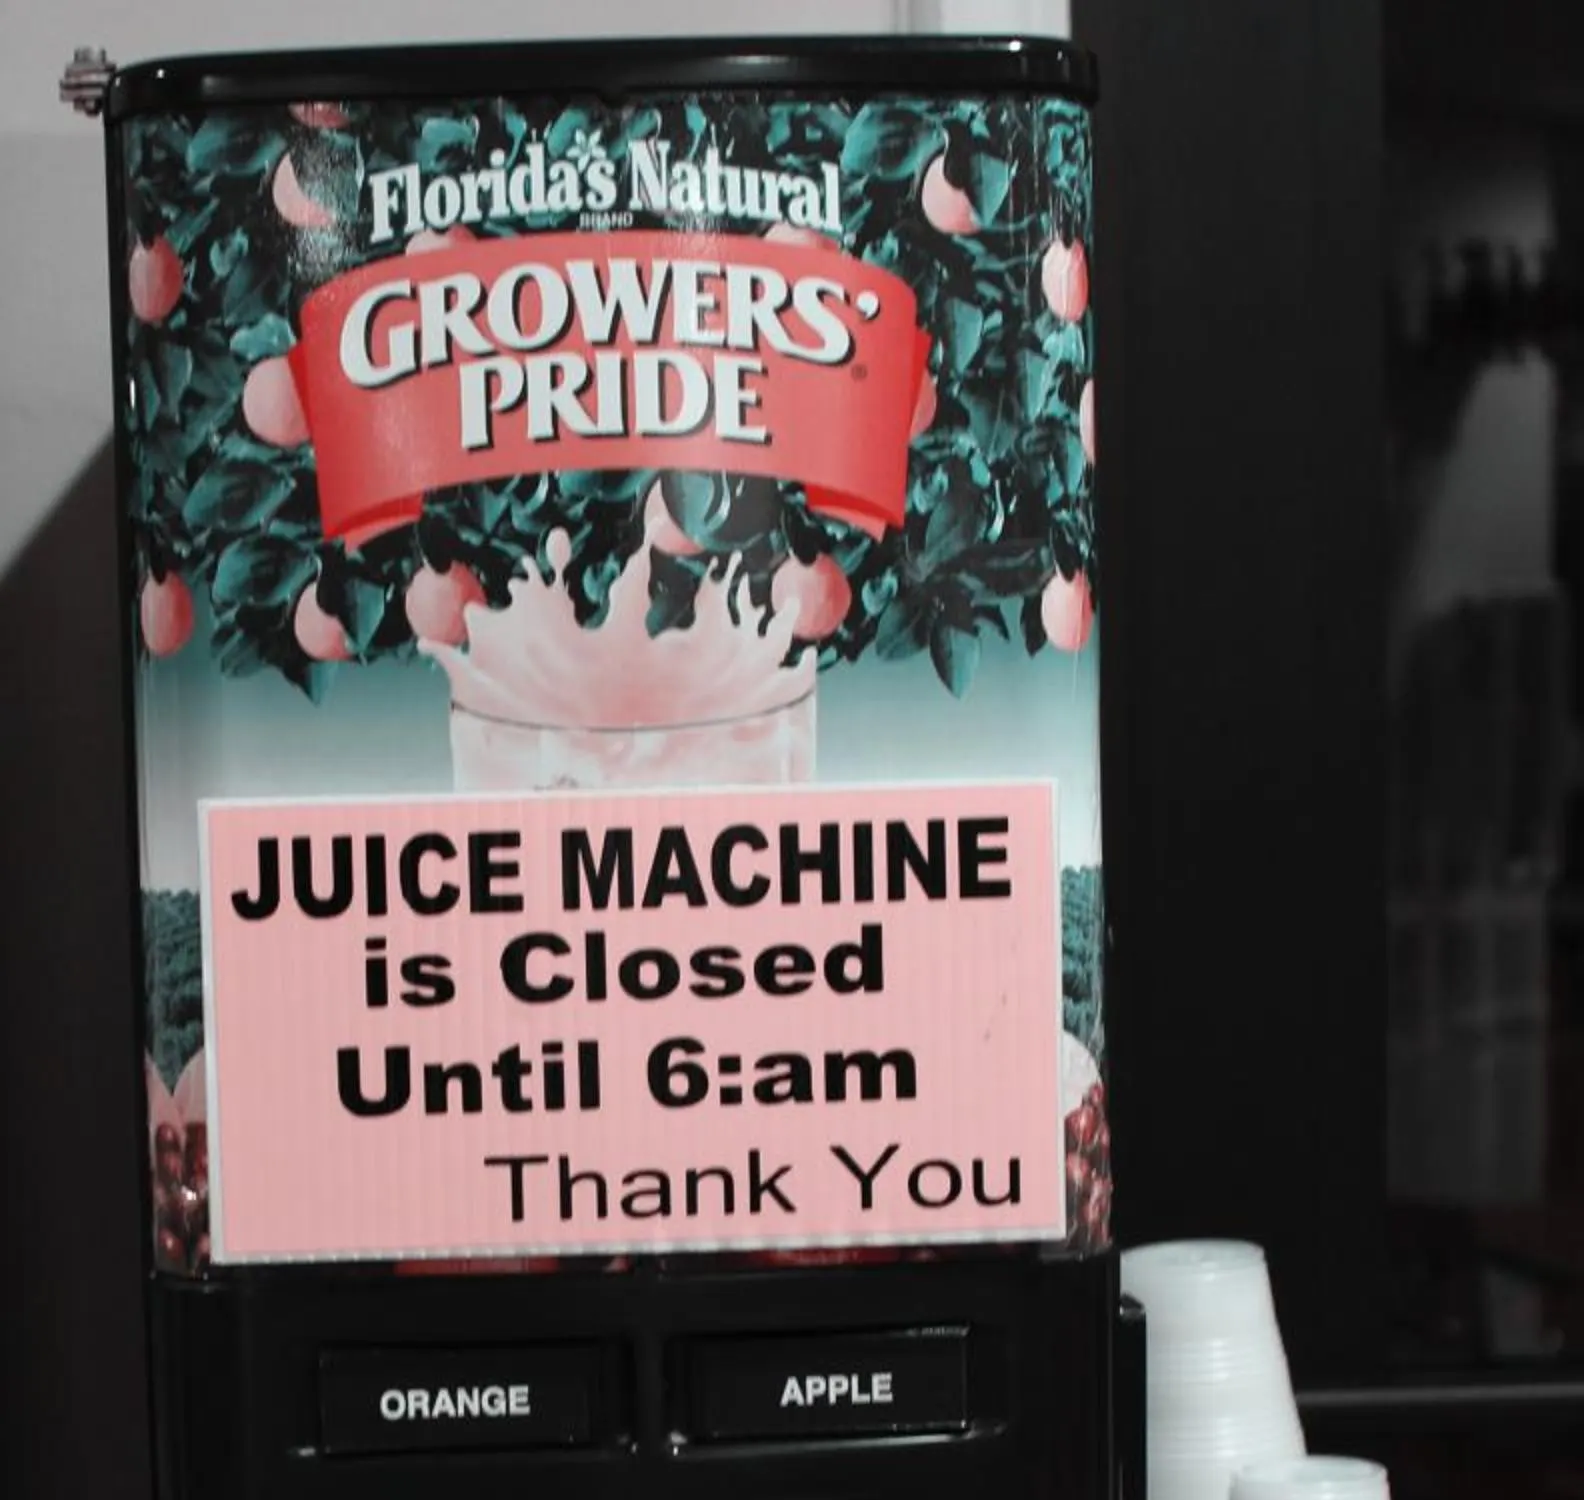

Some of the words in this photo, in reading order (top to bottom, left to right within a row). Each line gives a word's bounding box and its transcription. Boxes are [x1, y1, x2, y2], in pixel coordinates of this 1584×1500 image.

[628, 138, 843, 234] Natural
[458, 349, 773, 453] PRIDE
[230, 830, 525, 920] JUICE
[561, 816, 1013, 912] MACHINE
[364, 937, 457, 1008] is
[499, 924, 886, 1004] Closed
[336, 1040, 602, 1118] Until
[646, 1036, 920, 1109] 6:am
[484, 1149, 798, 1222] Thank
[830, 1143, 1022, 1213] You
[379, 1384, 531, 1422] ORANGE
[779, 1371, 894, 1407] APPLE
